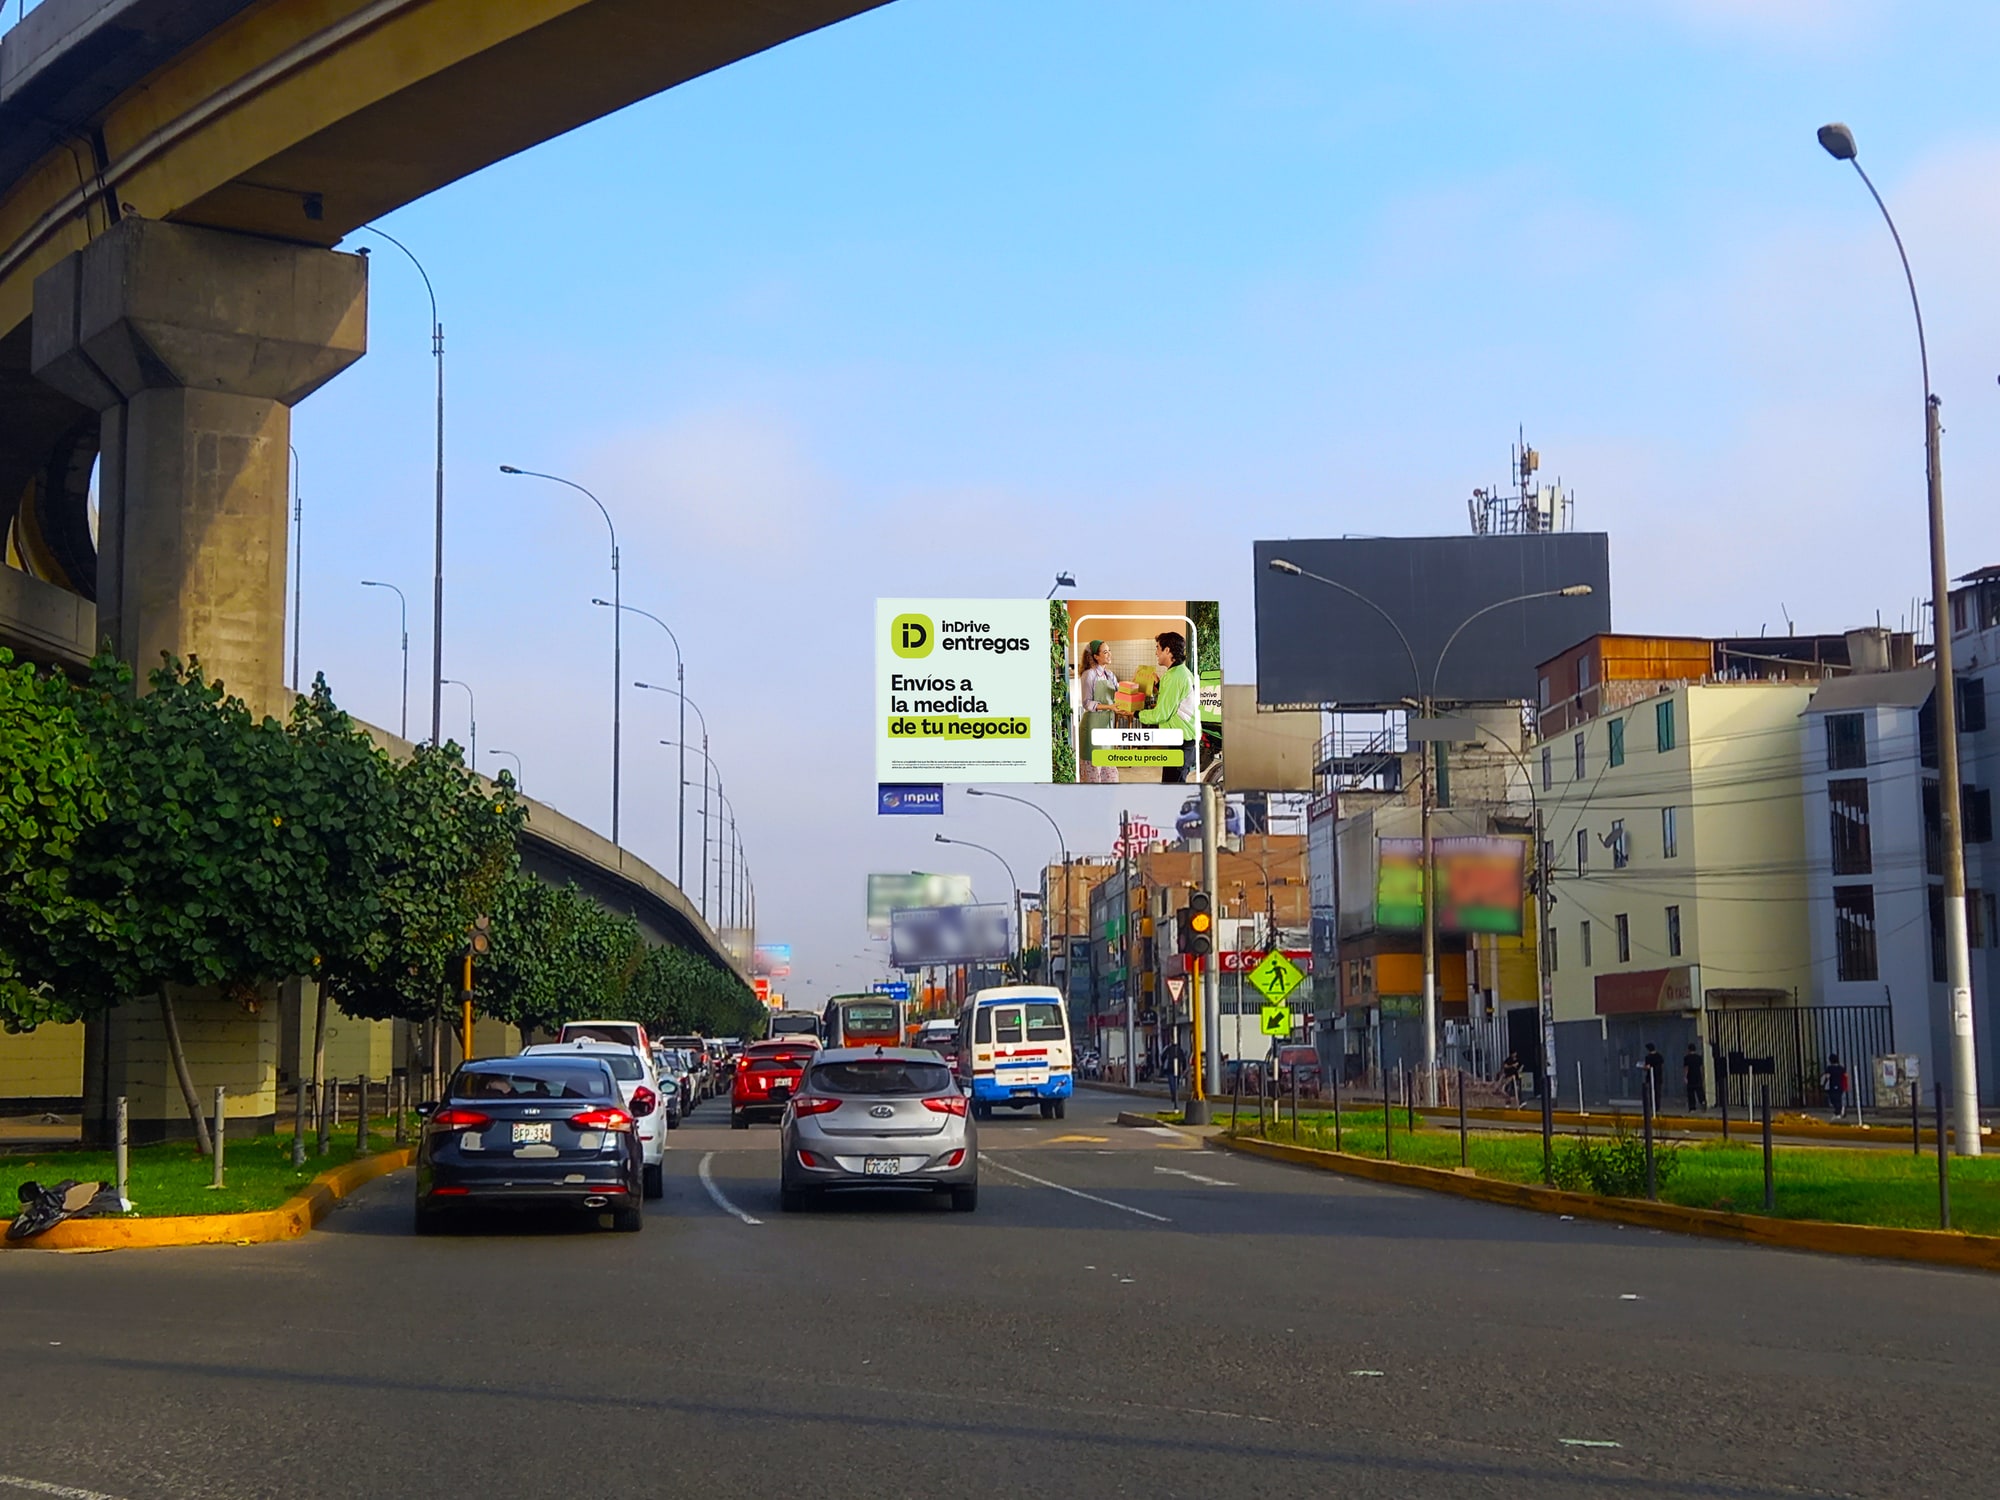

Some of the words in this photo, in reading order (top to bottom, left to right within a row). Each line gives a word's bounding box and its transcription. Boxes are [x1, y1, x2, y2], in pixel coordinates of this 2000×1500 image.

[942, 620, 990, 632] inDrive
[942, 636, 1030, 654] entregas
[891, 674, 956, 691] Envíos
[960, 678, 973, 691] a
[891, 695, 909, 713] la
[914, 695, 989, 713] medida
[891, 717, 916, 734] de
[921, 719, 944, 734] tu
[948, 717, 1027, 739] negocio
[1121, 732, 1141, 742] PEN
[1143, 732, 1150, 742] 5
[1107, 754, 1133, 762] Ofrece
[1143, 754, 1168, 763] precio
[903, 792, 940, 804] input
